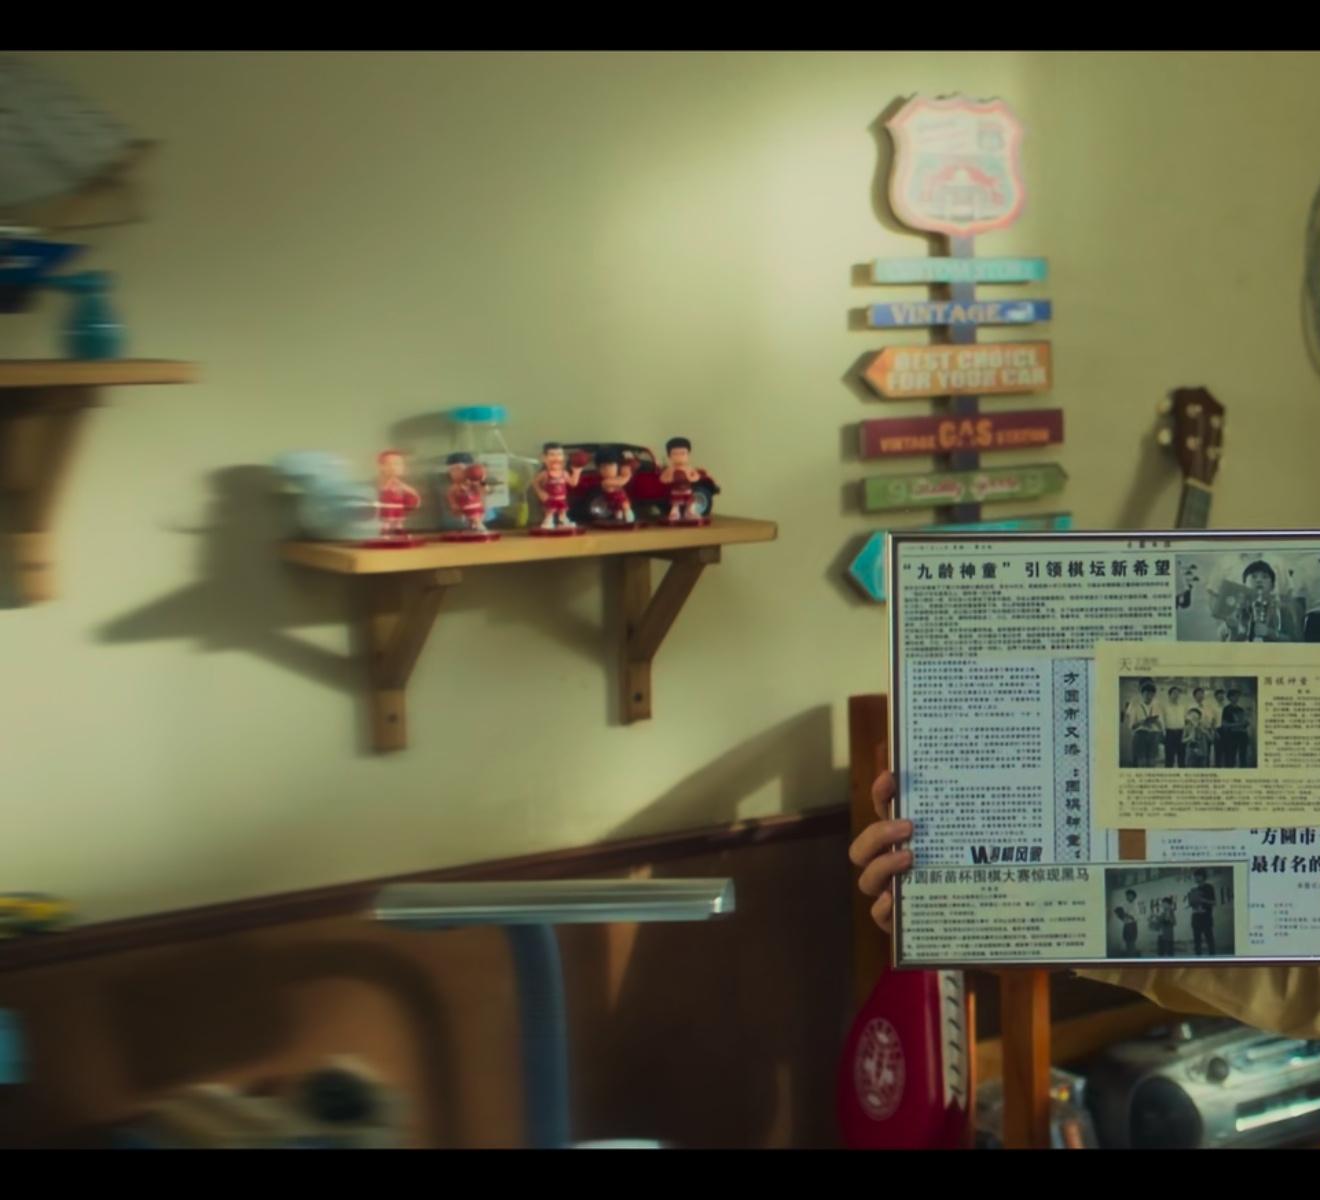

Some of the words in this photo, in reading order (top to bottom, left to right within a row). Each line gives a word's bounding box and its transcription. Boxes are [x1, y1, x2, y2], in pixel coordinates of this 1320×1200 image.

[890, 303, 1001, 324] VINTAGE
[893, 353, 950, 370] BEST
[957, 349, 1039, 369] CHOICE
[887, 372, 931, 389] FOR
[936, 370, 996, 387] YOUR
[1001, 367, 1046, 385] CAR
[938, 418, 993, 449] GAS
